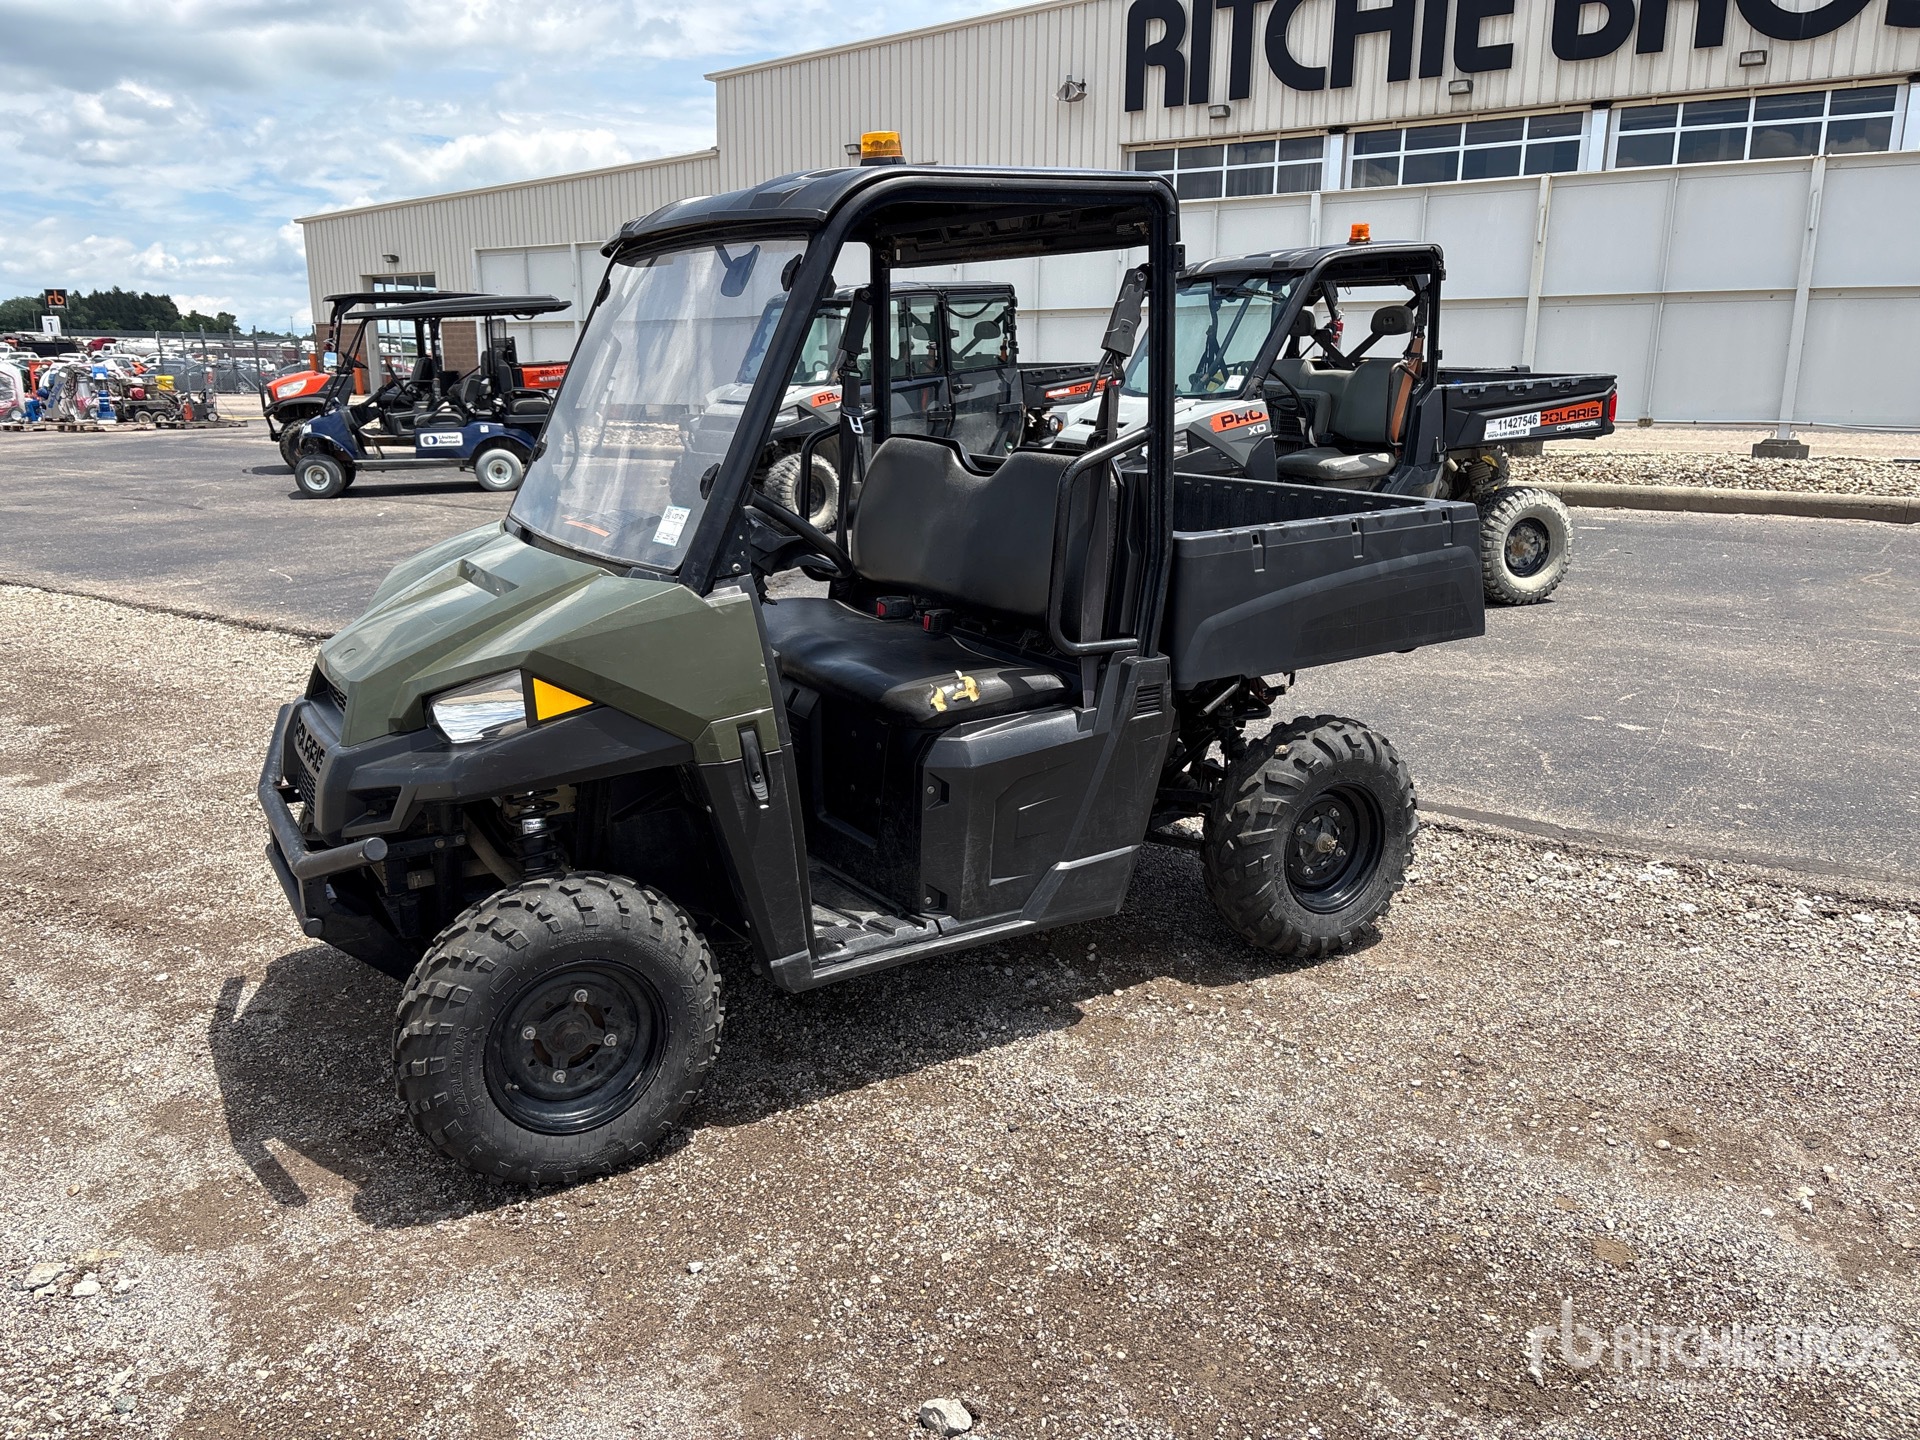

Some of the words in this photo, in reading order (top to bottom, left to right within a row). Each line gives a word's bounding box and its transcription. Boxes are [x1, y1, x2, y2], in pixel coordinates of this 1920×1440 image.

[48, 322, 54, 332] 1
[1498, 413, 1538, 431] 11427546
[1540, 406, 1600, 424] POLARIS
[1247, 423, 1267, 436] XD
